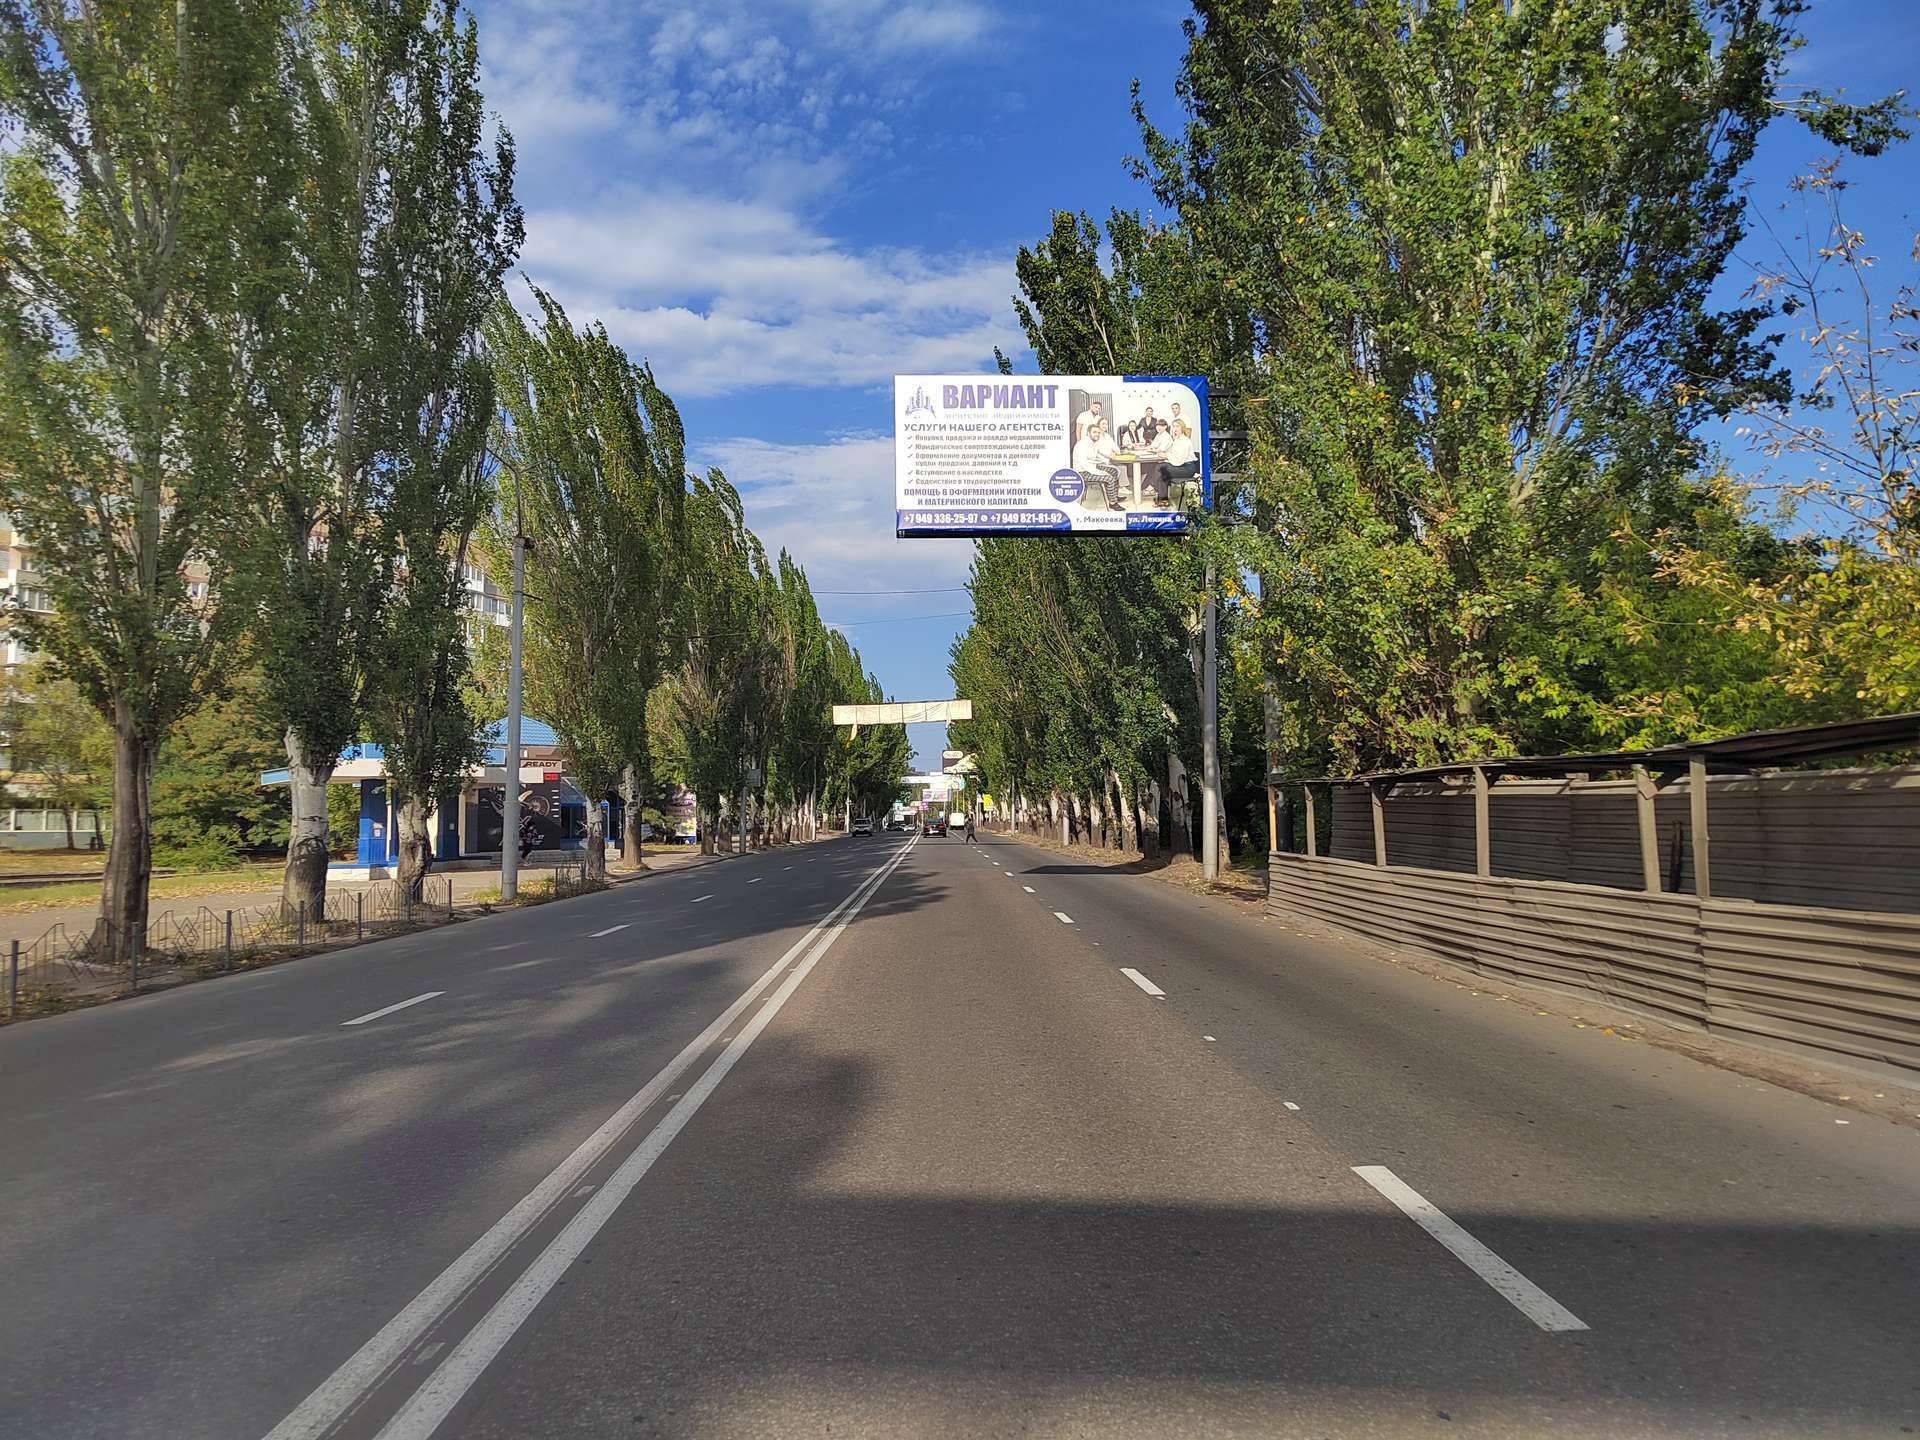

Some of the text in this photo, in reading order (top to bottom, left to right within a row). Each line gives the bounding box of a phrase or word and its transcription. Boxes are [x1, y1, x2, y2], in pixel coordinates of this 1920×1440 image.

[942, 384, 1059, 409] ВАРИАНТ
[903, 423, 1065, 432] УСЛУГИ НАШЕГО АГЕНТСТВА:
[904, 488, 1042, 497] ПОМОЩЬ В ОФОРМЛЕНИИ ИПОТЕКИ
[1055, 488, 1063, 497] 10
[917, 498, 1028, 506] И МАТЕРИНСКОГО КАПИТАЛА
[1002, 513, 1019, 524] 949
[1128, 516, 1141, 524] ул.
